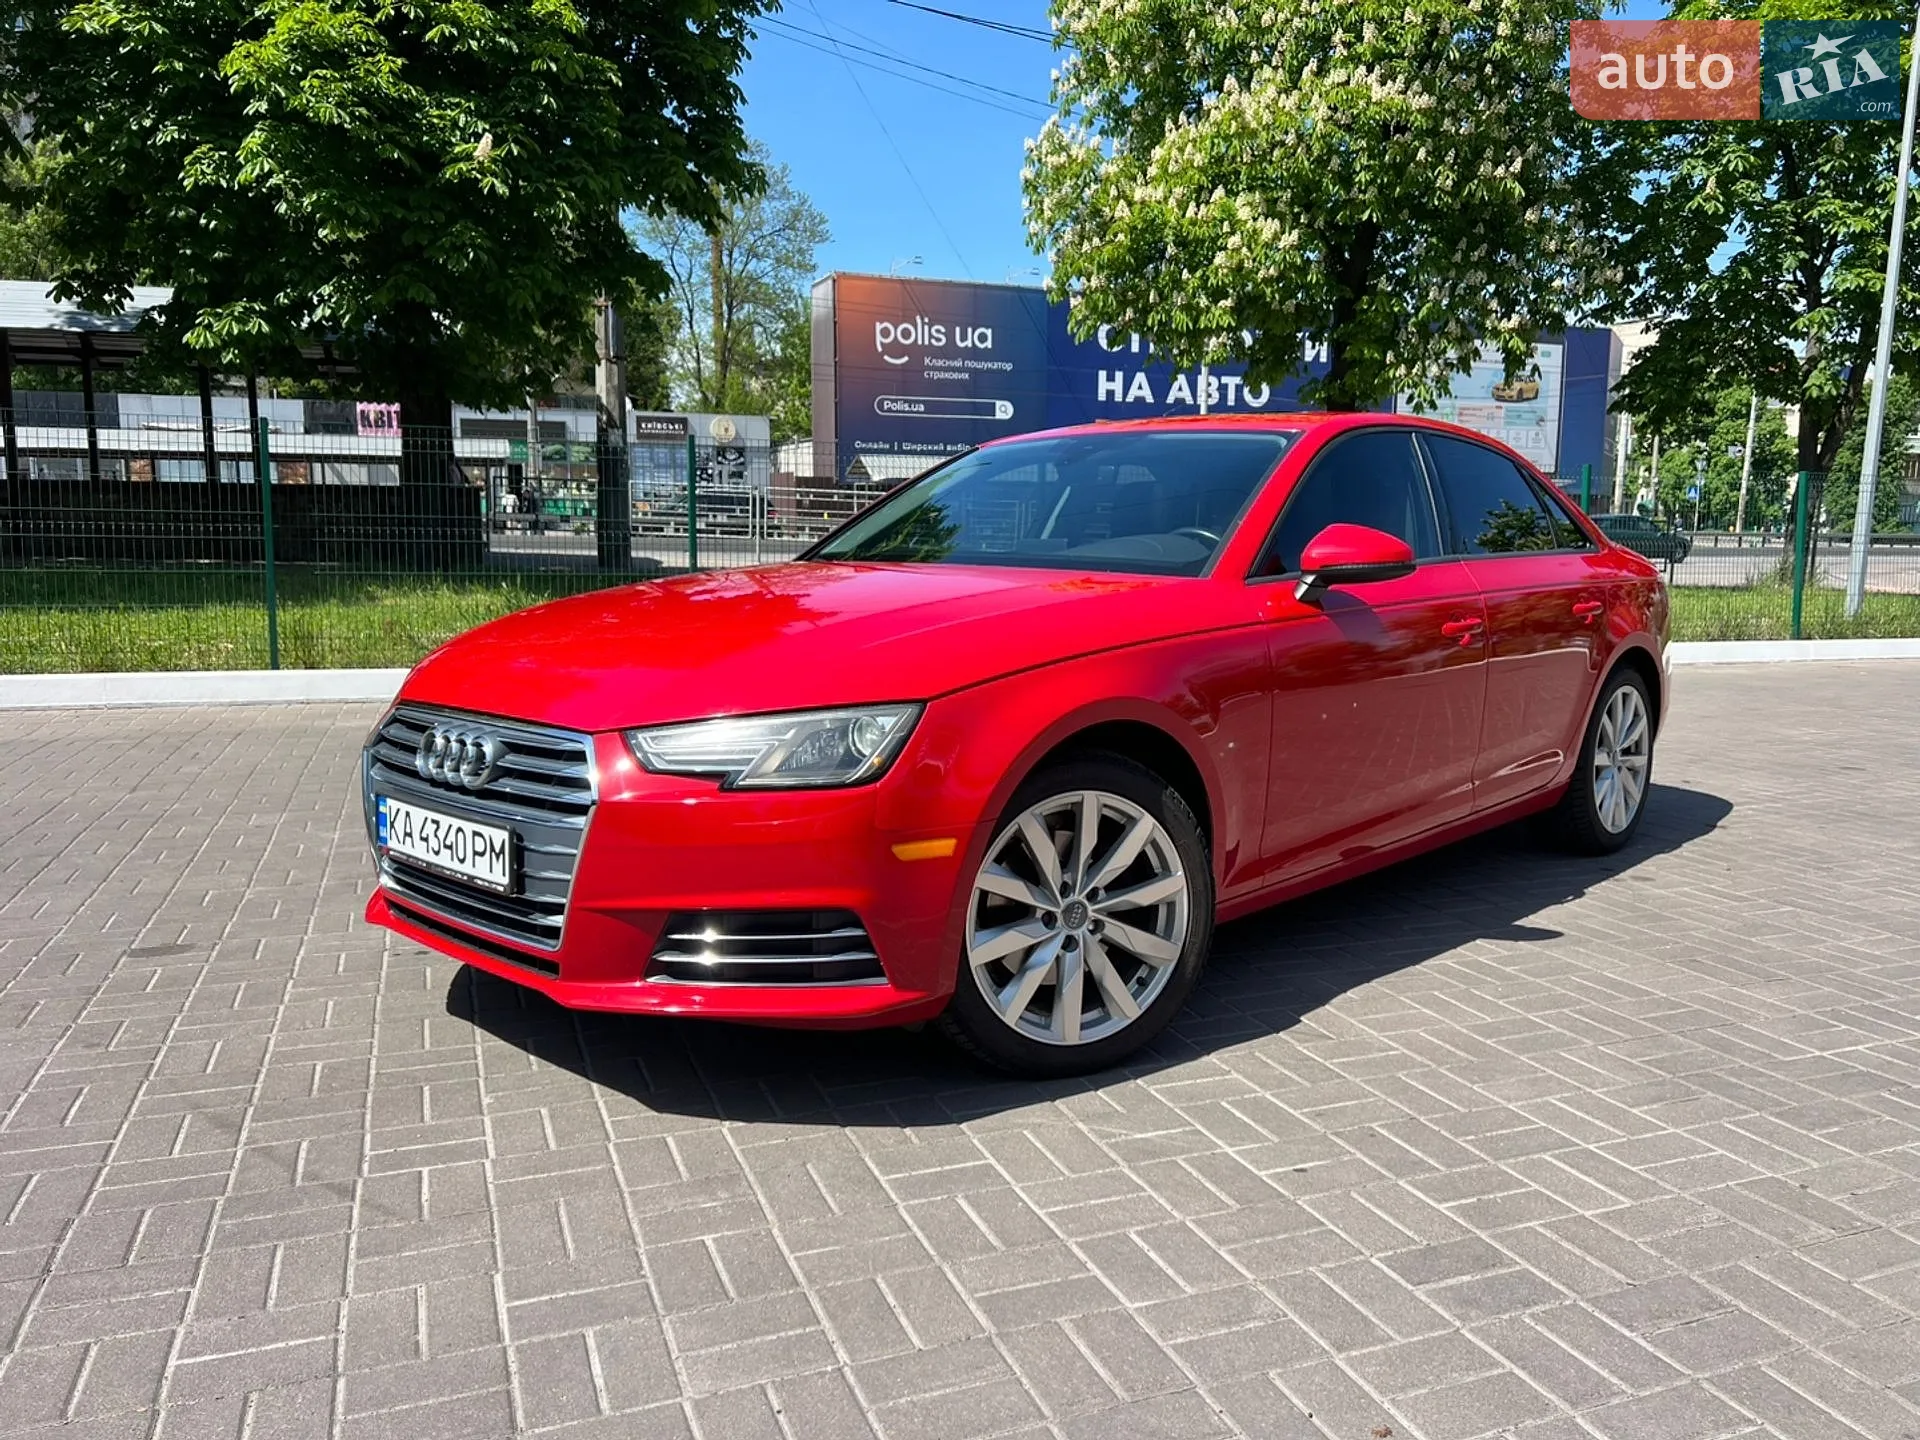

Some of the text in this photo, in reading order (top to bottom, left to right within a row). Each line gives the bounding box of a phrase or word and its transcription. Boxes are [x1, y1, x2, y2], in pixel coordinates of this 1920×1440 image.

[875, 315, 993, 352] polis ua
[924, 356, 1014, 372] Класний пошукатор
[924, 370, 970, 380] страхових
[1097, 370, 1271, 408] НА АВТО
[883, 400, 925, 412] Polis.ua
[854, 440, 890, 449] Онлайн
[419, 816, 467, 865] 4340
